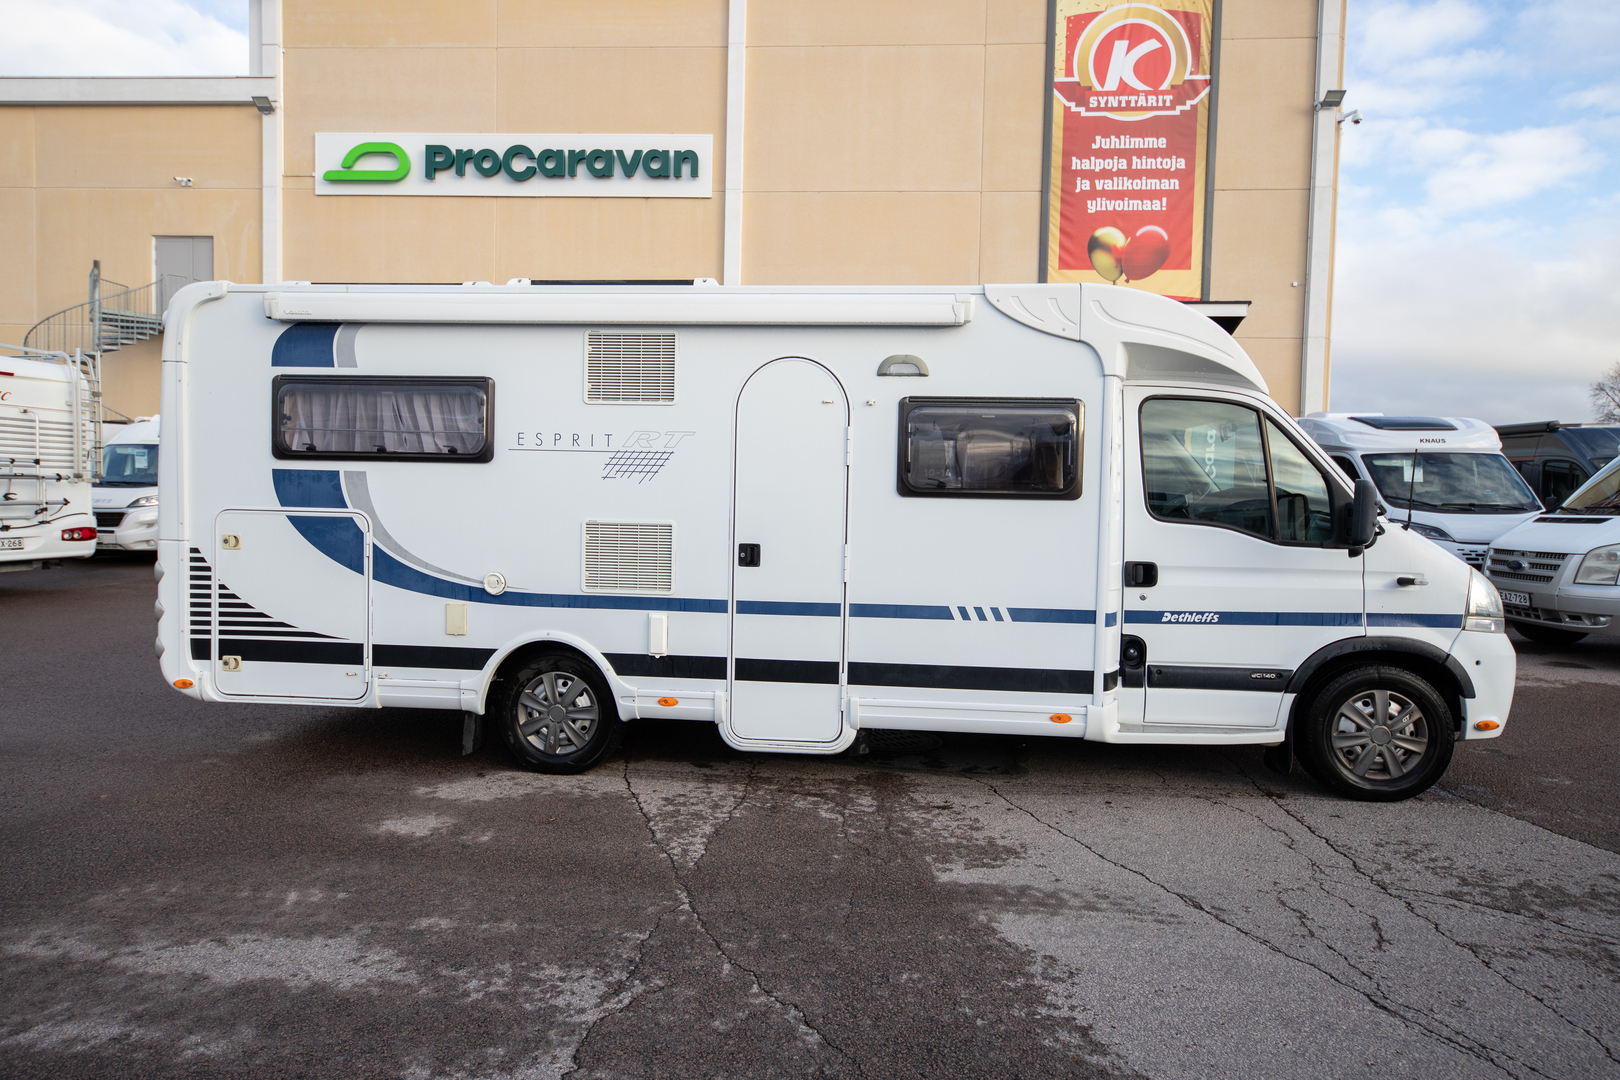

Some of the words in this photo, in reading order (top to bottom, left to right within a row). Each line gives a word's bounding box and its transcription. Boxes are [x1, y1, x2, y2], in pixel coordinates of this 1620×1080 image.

[1089, 93, 1173, 108] SYNTTÄRIT
[1091, 135, 1167, 149] Juhlimme
[424, 144, 699, 181] ProCaravan
[1071, 156, 1127, 172] halpoja
[1131, 155, 1186, 171] hintoja
[1075, 177, 1090, 193] ja
[1094, 176, 1179, 190] valikoiman
[1087, 197, 1167, 213] ylivoimaa!
[517, 432, 613, 447] ESPRIT
[622, 430, 696, 448] RT
[1161, 612, 1220, 623] Dethleffs
